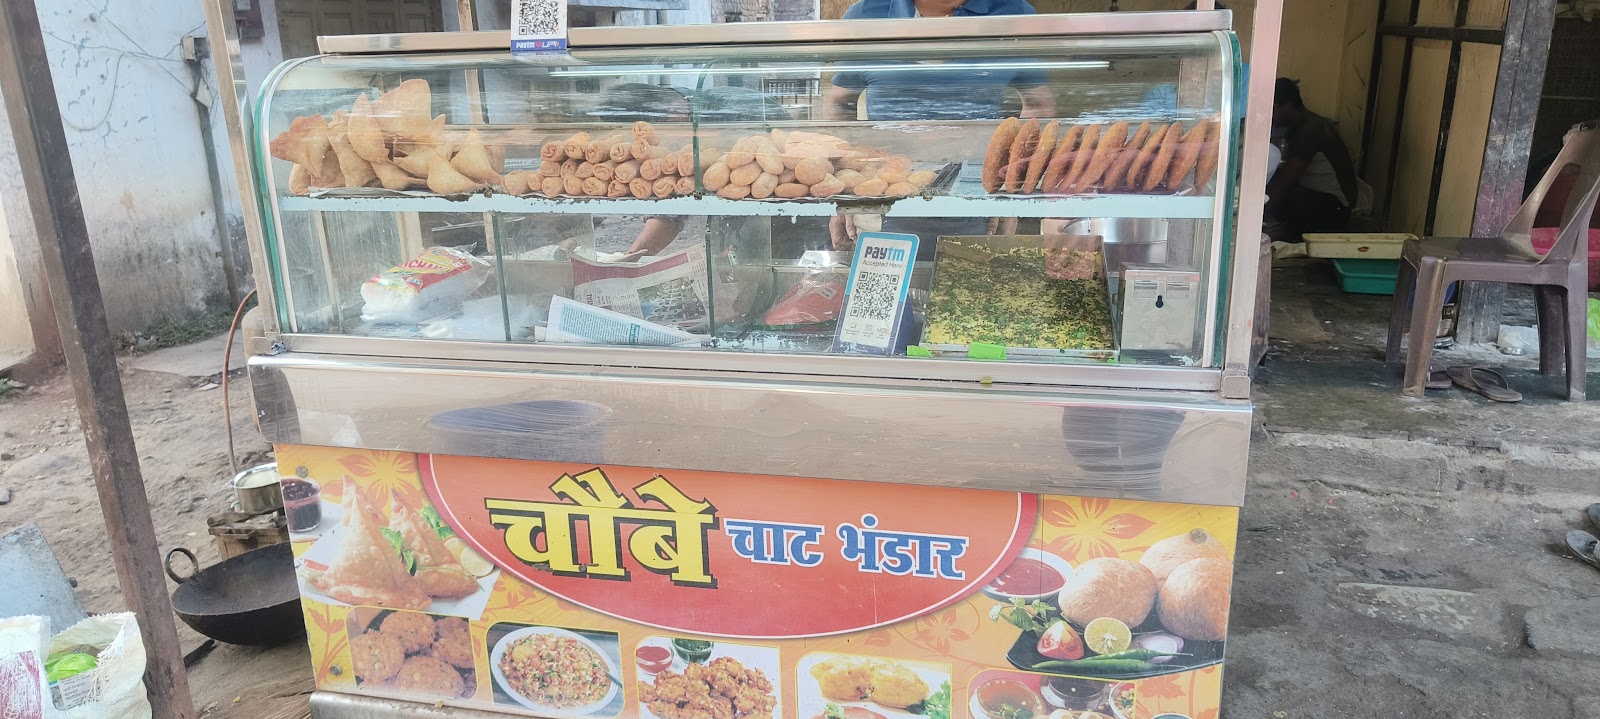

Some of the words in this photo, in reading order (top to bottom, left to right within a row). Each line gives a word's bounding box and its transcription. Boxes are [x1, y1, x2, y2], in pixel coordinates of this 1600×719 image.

[862, 260, 888, 268] Accepted
[485, 467, 718, 589] चौबे
[724, 518, 825, 567] चाट
[837, 513, 969, 581] भंडार
